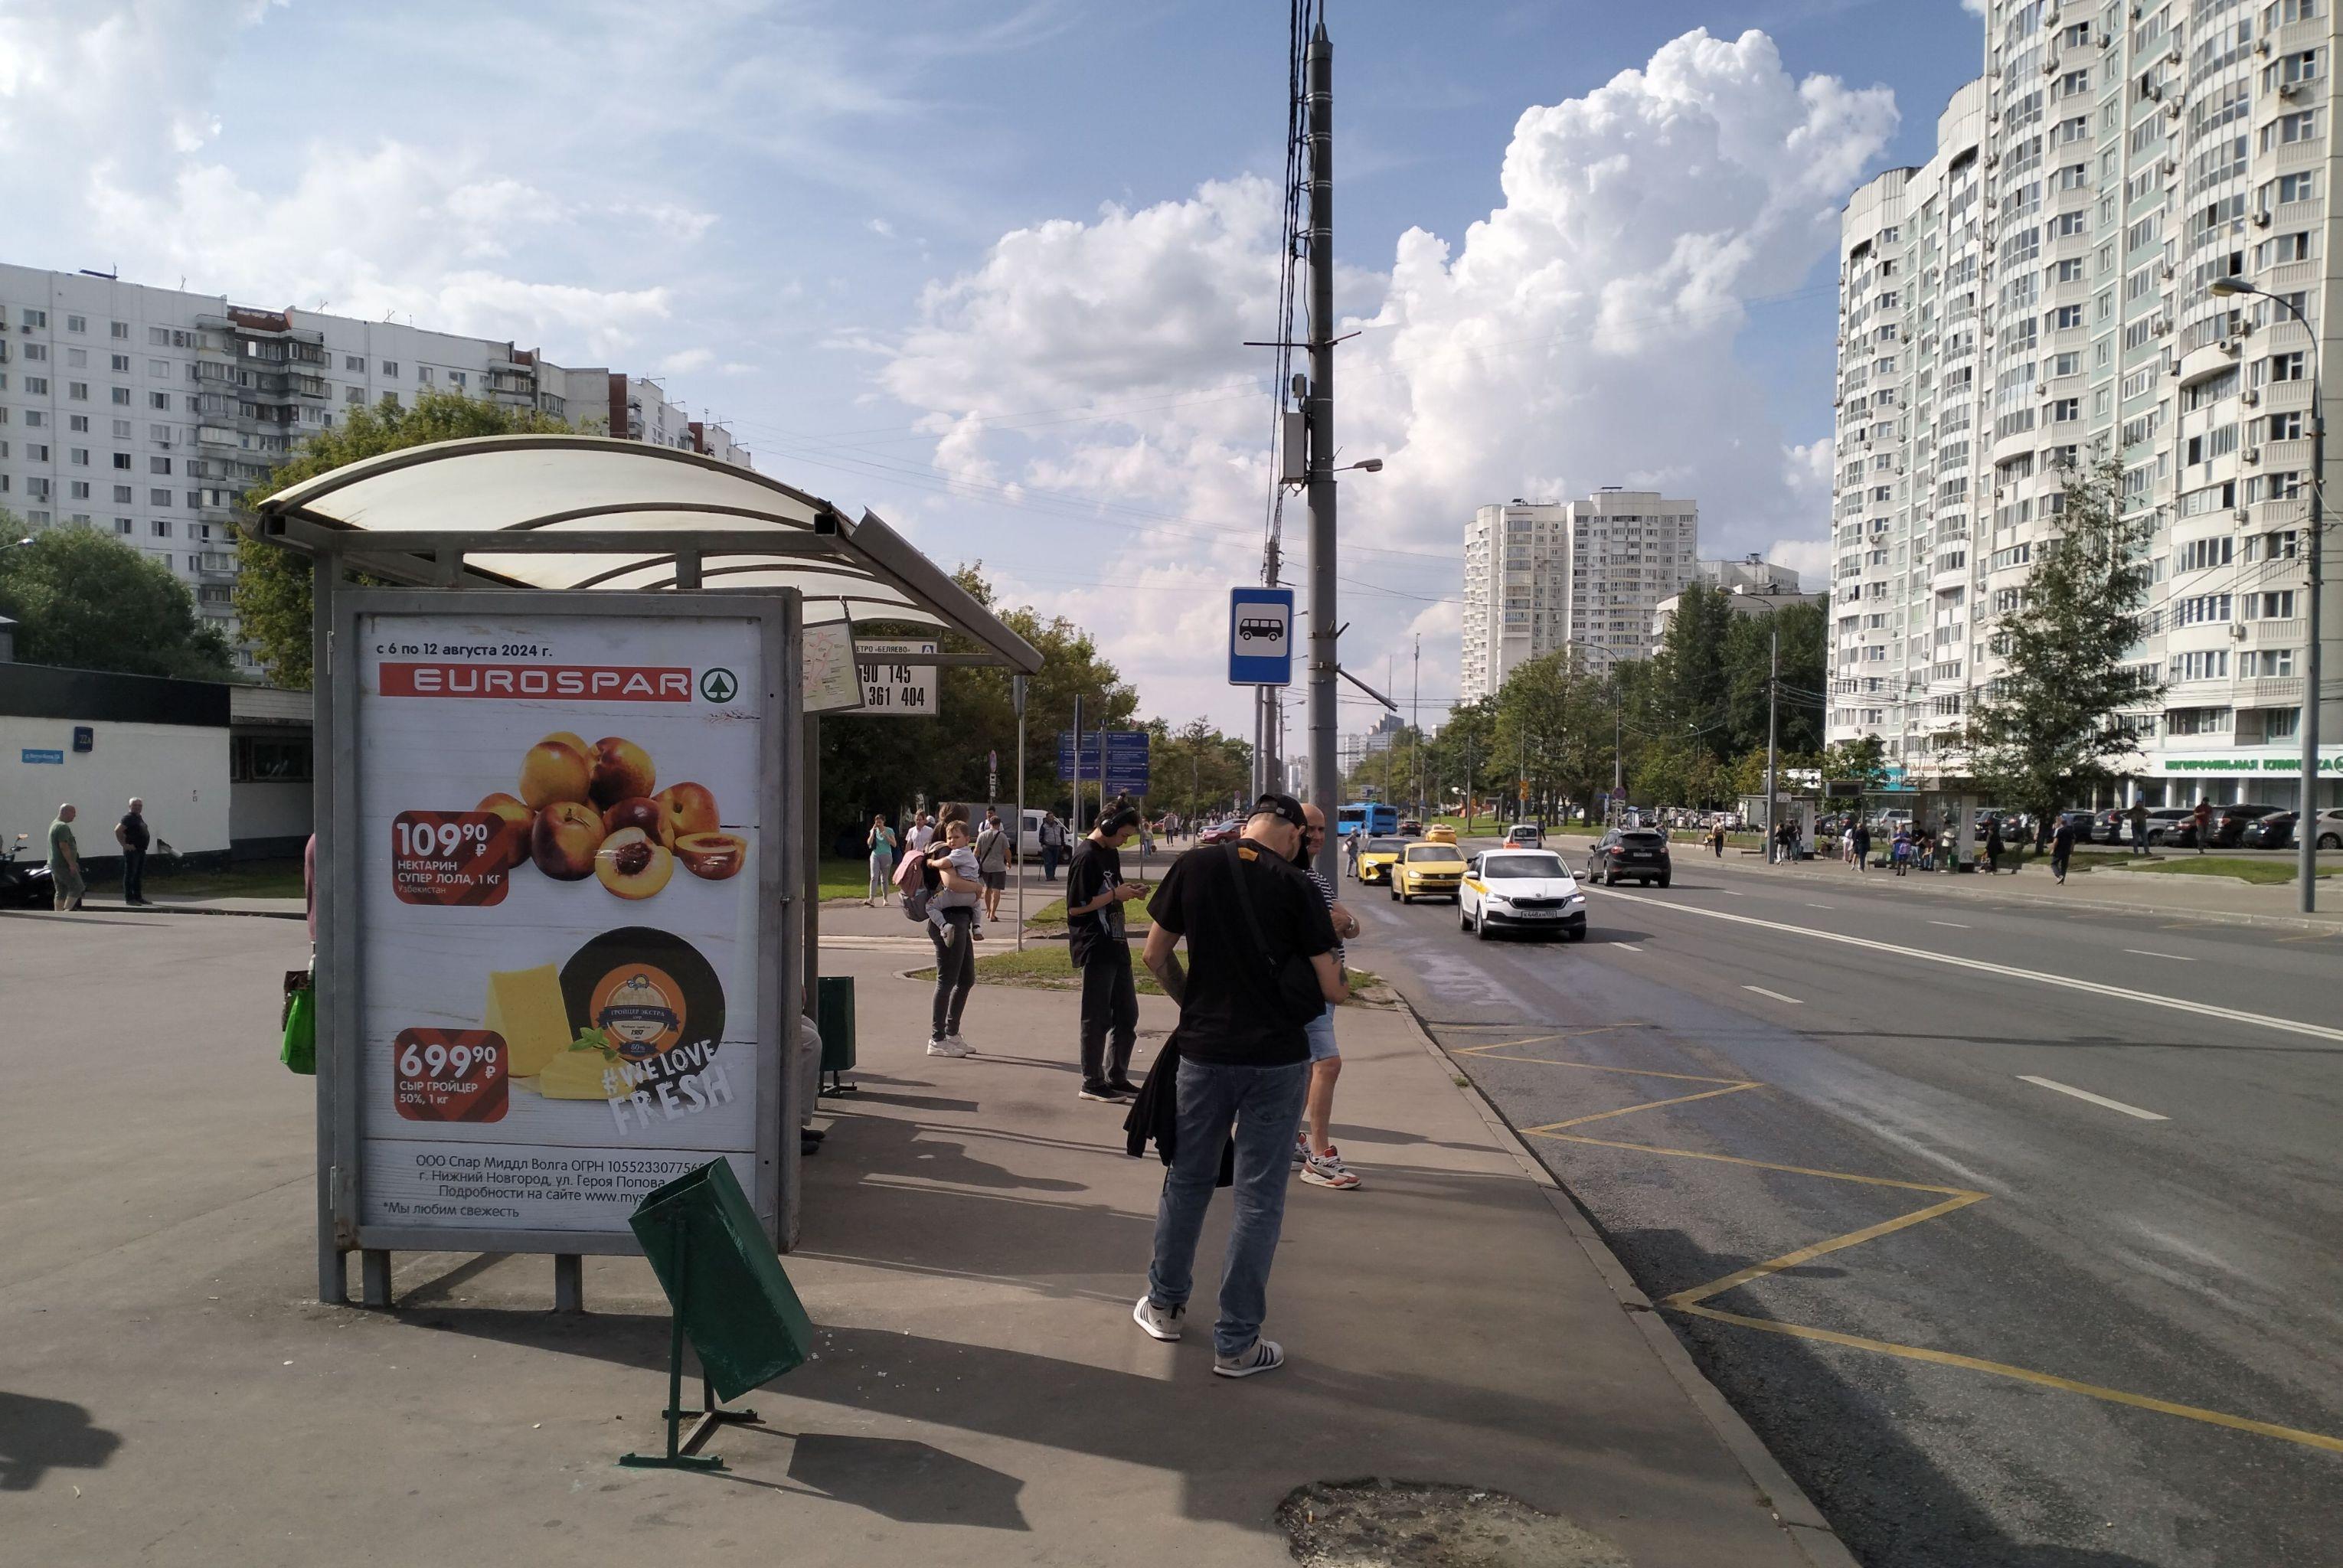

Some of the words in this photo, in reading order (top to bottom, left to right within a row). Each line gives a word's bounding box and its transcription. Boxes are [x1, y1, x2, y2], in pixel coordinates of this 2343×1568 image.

[376, 645, 384, 654] с
[388, 642, 397, 655] 6
[401, 645, 419, 655] по
[423, 643, 438, 655] 12
[442, 645, 498, 658] августа
[502, 645, 538, 657] 2024
[542, 647, 553, 657] г.
[413, 668, 688, 696] EUROSPAR
[889, 665, 911, 684] 145
[868, 686, 890, 706] 361
[900, 687, 925, 707] 404
[397, 822, 462, 857] 109
[397, 860, 458, 871] НЕКТАРИН
[397, 872, 433, 883] СУПЕР
[436, 874, 475, 886] ЛОЛА,
[478, 874, 483, 884] 1
[487, 874, 501, 884] КГ
[397, 885, 447, 894] Узбекистан
[399, 1044, 472, 1079] 699
[658, 1039, 717, 1076] LOVE
[399, 1080, 424, 1091] СЫР
[426, 1080, 479, 1094] ГРОЙЦЕР
[399, 1093, 426, 1105] 50%,
[429, 1094, 433, 1103] 1
[416, 1155, 446, 1167] ООО
[449, 1155, 481, 1170] Спар
[484, 1157, 528, 1171] Миддл
[531, 1158, 567, 1171] Волга
[571, 1160, 604, 1172] ОГРН
[419, 1171, 429, 1181] г.
[432, 1170, 483, 1183] Нижний
[486, 1172, 552, 1187] Новгород,
[555, 1176, 573, 1186] ул.
[577, 1175, 613, 1189] Героя
[616, 1176, 665, 1187] Попова
[439, 1184, 524, 1200] Подробности
[527, 1190, 542, 1200] на
[546, 1189, 582, 1200] сайте
[413, 1204, 457, 1216] любим
[460, 1206, 519, 1217] свежесть
